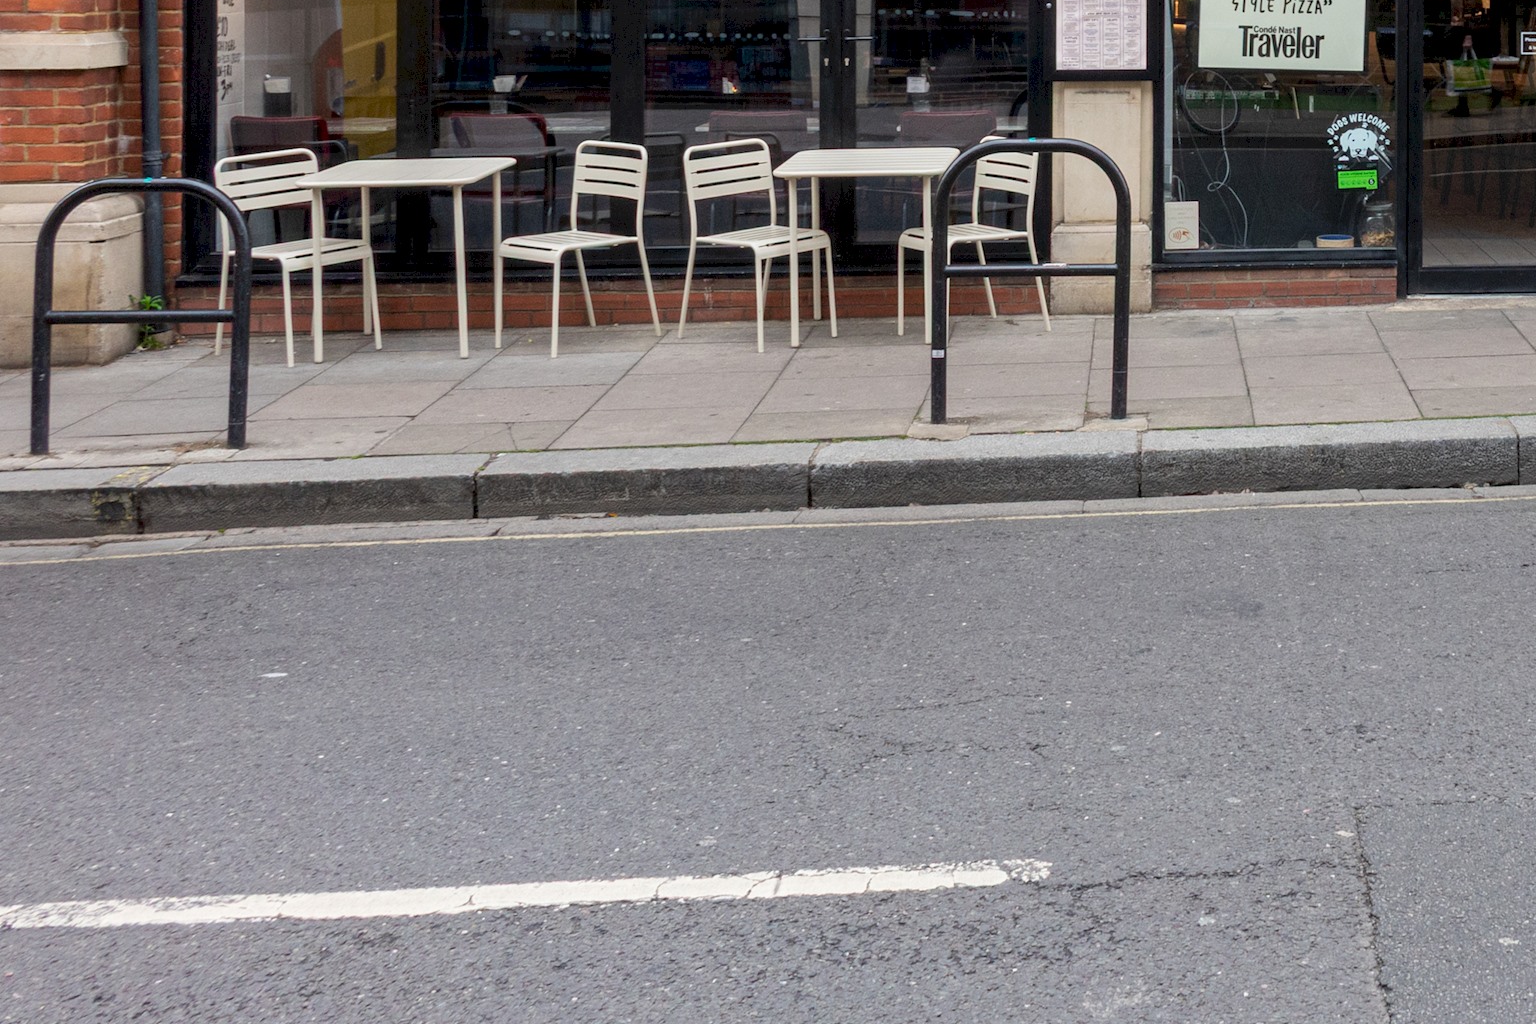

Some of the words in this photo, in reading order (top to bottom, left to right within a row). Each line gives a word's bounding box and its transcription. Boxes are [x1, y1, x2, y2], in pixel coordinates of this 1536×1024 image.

[1278, 26, 1296, 34] Nast
[1239, 25, 1325, 59] Traveler
[1327, 116, 1349, 136] DOGS
[1349, 113, 1391, 133] WELCOME
